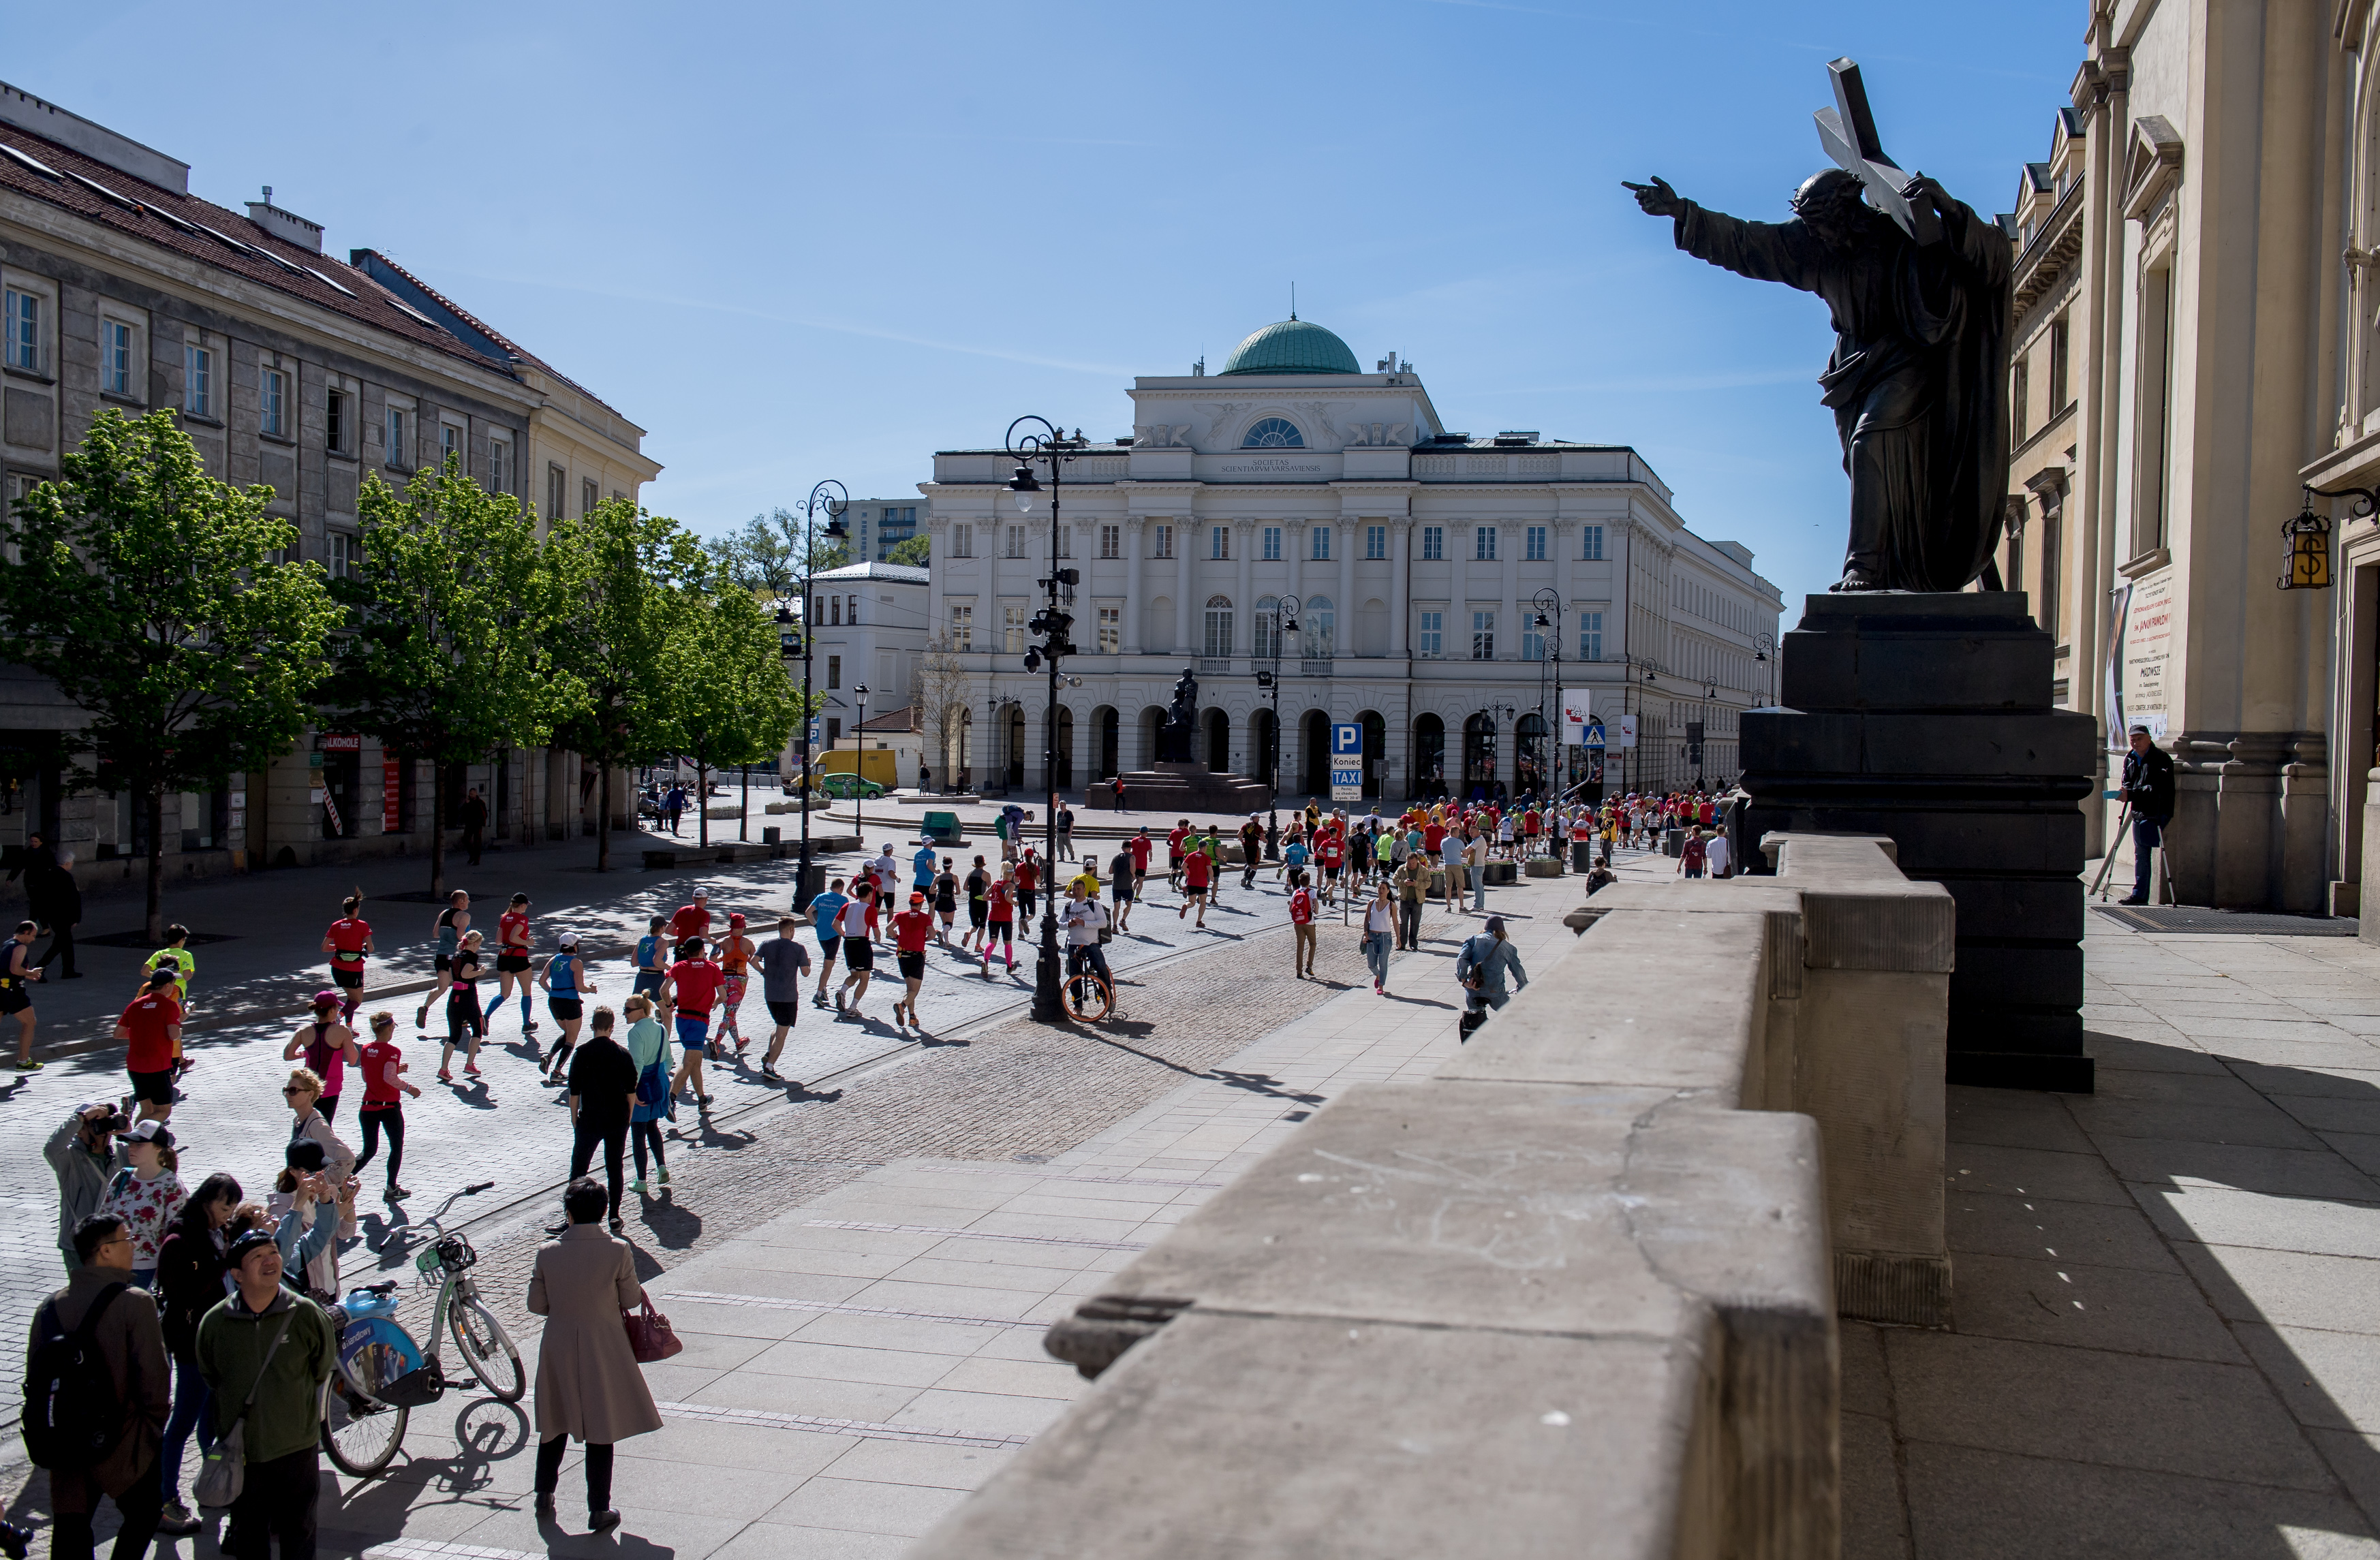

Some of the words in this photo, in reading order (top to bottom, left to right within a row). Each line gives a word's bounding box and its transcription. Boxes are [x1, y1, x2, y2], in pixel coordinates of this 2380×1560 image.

[810, 730, 818, 740] P
[1339, 727, 1356, 751] P
[1334, 758, 1361, 766] Koniec
[1334, 772, 1361, 783] TAXI
